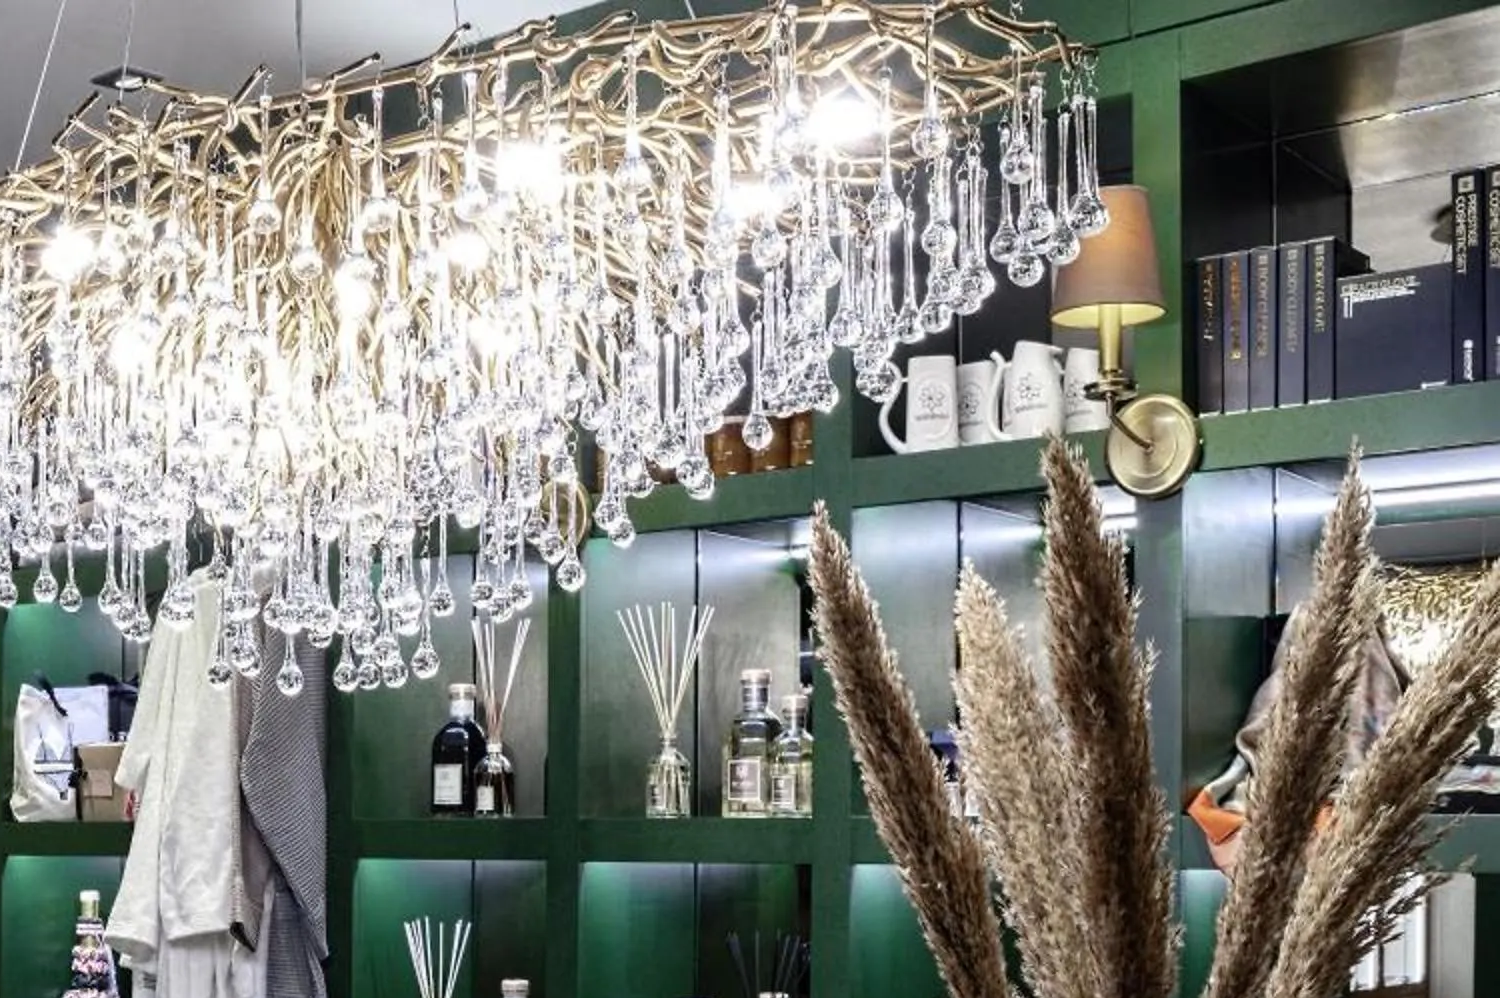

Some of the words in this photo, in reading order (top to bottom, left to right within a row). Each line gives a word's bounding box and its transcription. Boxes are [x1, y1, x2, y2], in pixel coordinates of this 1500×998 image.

[1456, 195, 1467, 252] COSMETIC
[1467, 193, 1478, 247] PRESTIGE
[1455, 253, 1466, 274] SET
